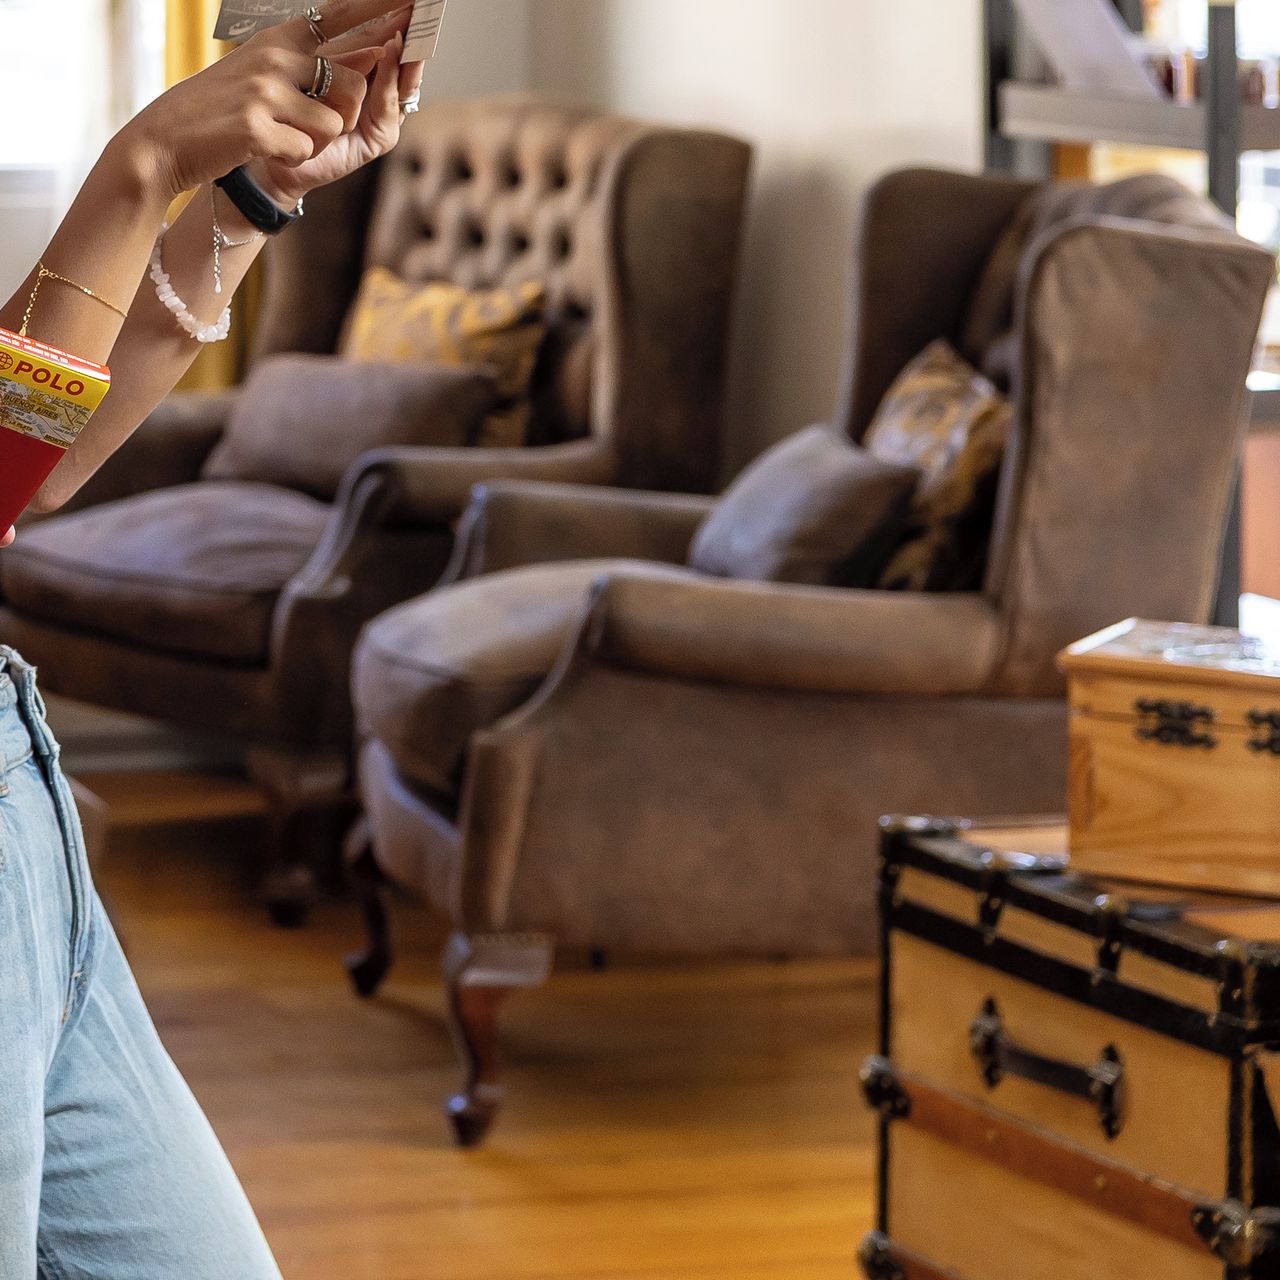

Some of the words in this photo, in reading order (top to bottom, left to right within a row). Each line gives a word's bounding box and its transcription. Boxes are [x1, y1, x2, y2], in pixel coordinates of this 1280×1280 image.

[13, 360, 84, 396] POLO
[2, 394, 35, 410] BUENOS
[34, 406, 58, 420] AIRES
